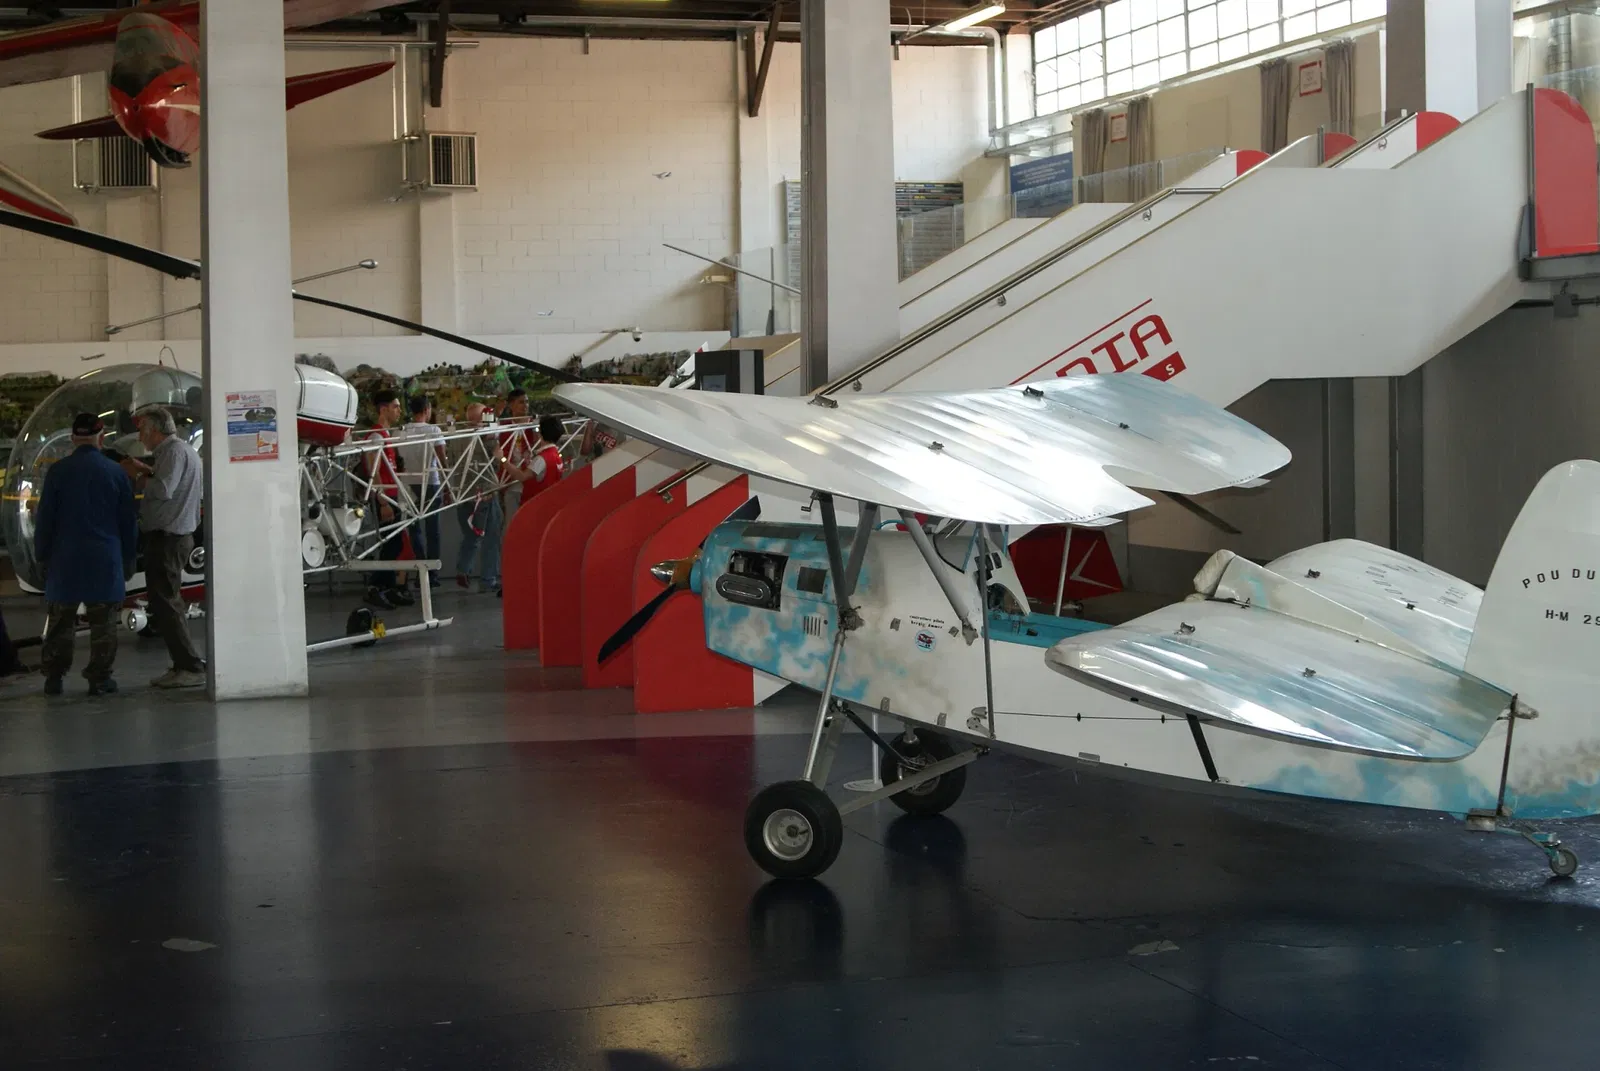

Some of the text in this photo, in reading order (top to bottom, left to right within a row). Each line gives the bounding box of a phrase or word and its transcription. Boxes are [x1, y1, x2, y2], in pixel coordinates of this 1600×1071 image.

[1522, 568, 1595, 588] POU DU
[1545, 609, 1569, 622] H-M
